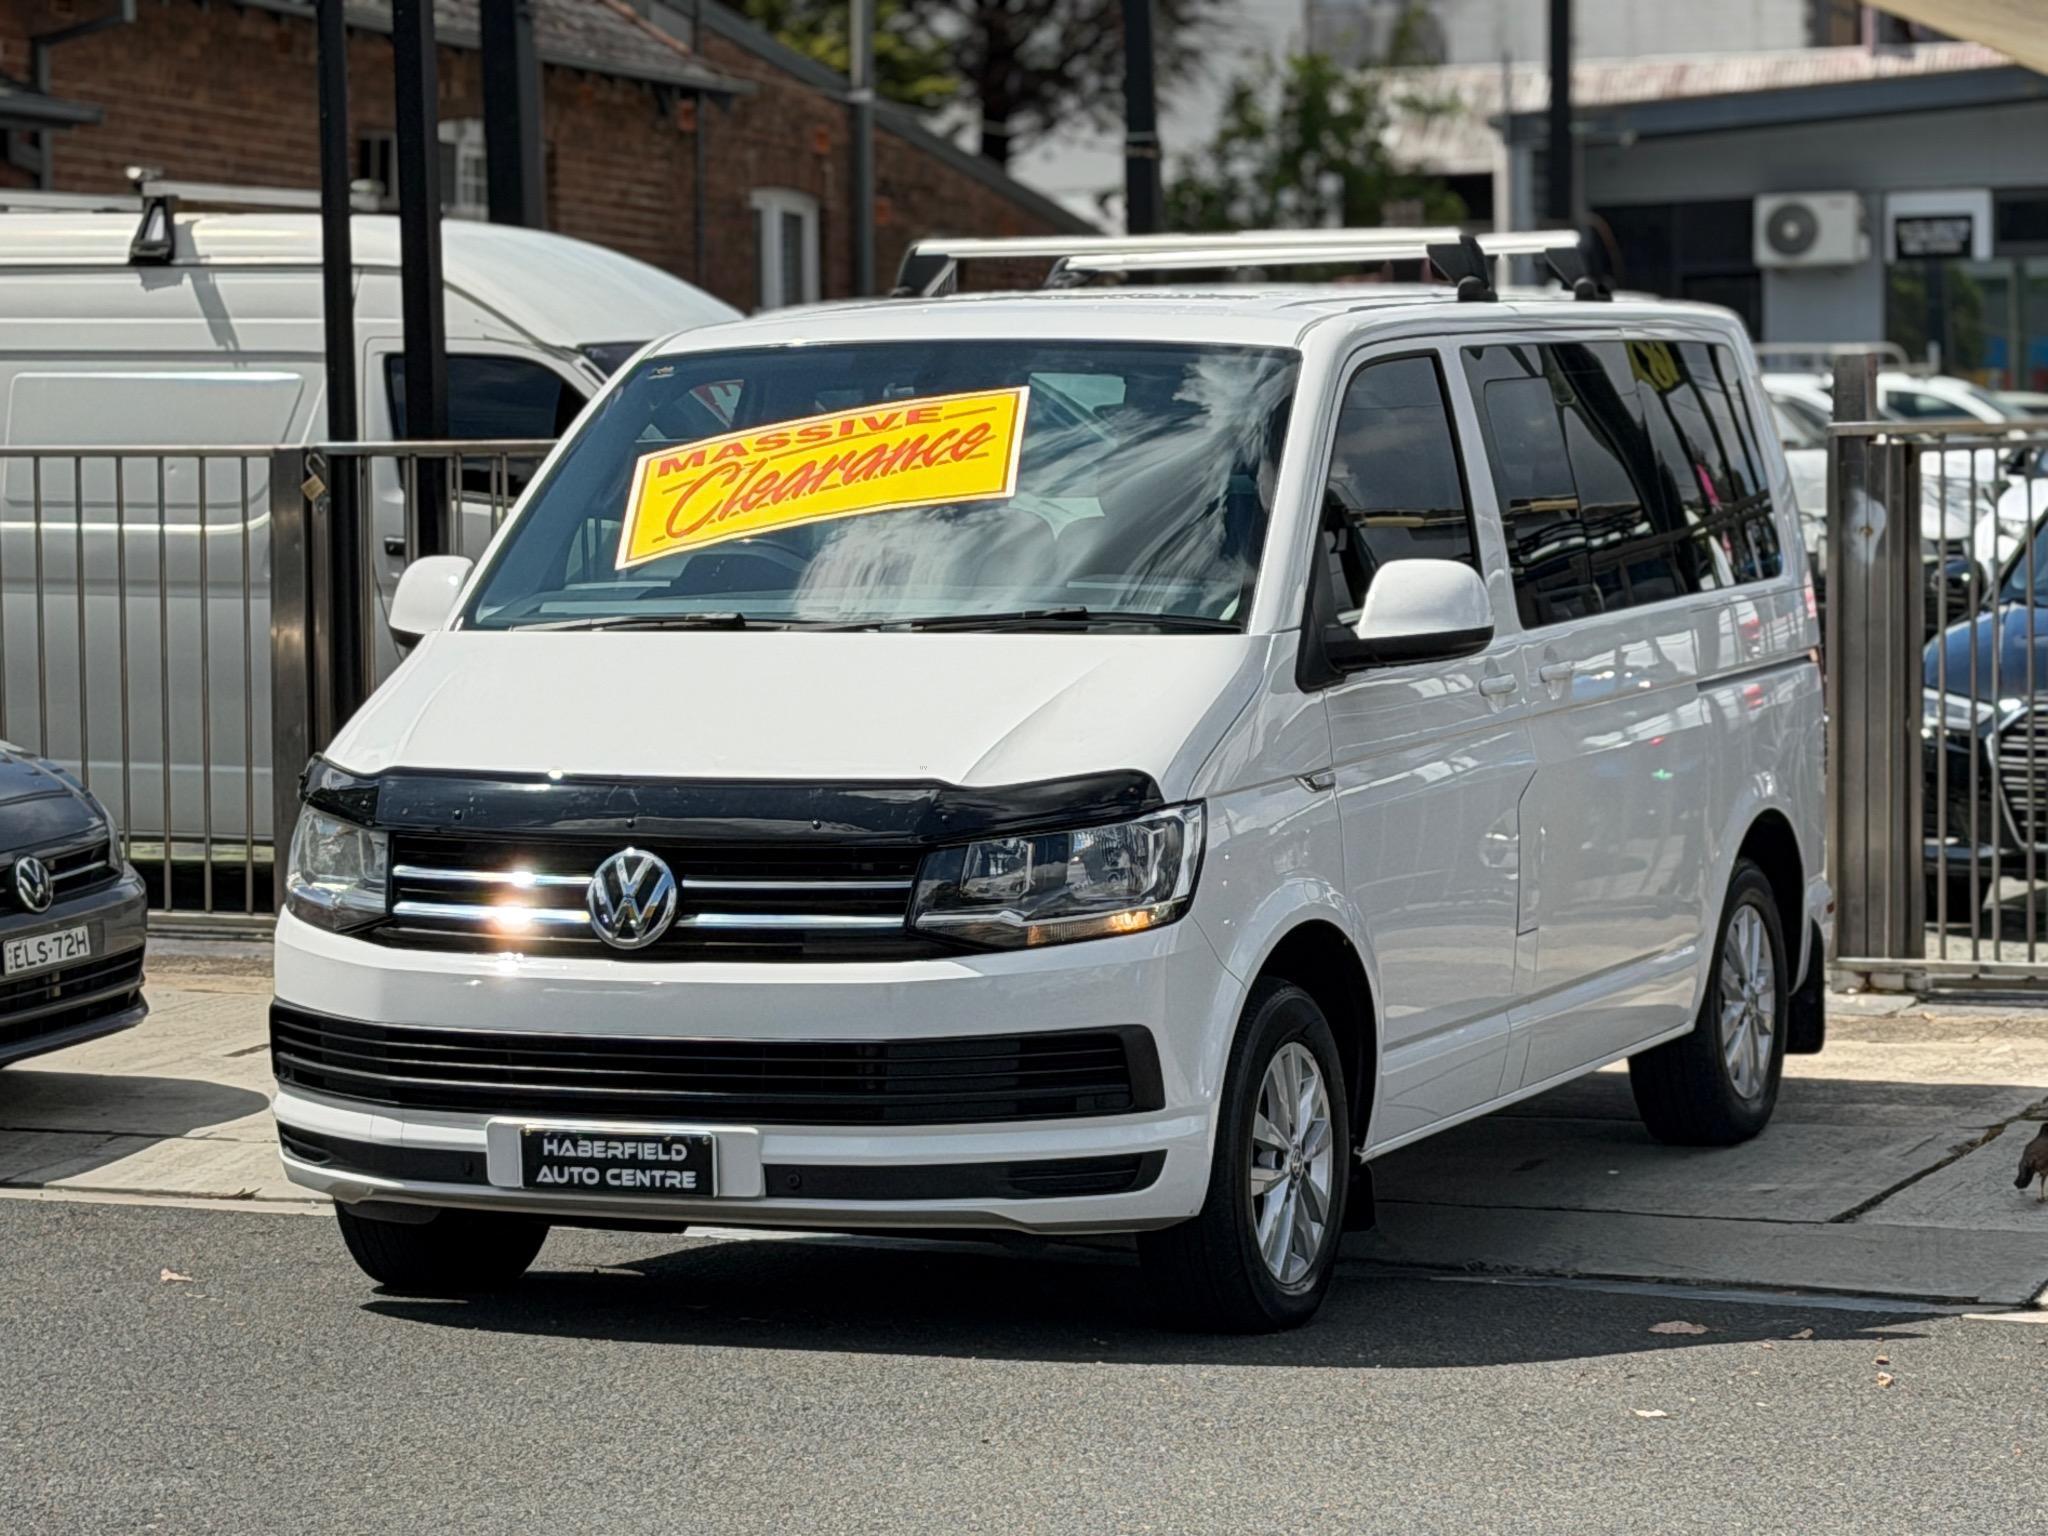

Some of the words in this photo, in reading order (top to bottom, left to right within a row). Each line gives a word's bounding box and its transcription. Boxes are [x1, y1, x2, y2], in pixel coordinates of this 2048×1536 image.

[657, 406, 944, 477] MASSIVE
[665, 421, 991, 538] Clearance
[590, 851, 674, 944] VW
[536, 1165, 600, 1185] AUTO
[606, 1169, 696, 1189] CENTRE
[543, 1139, 687, 1161] HABERFIELD
